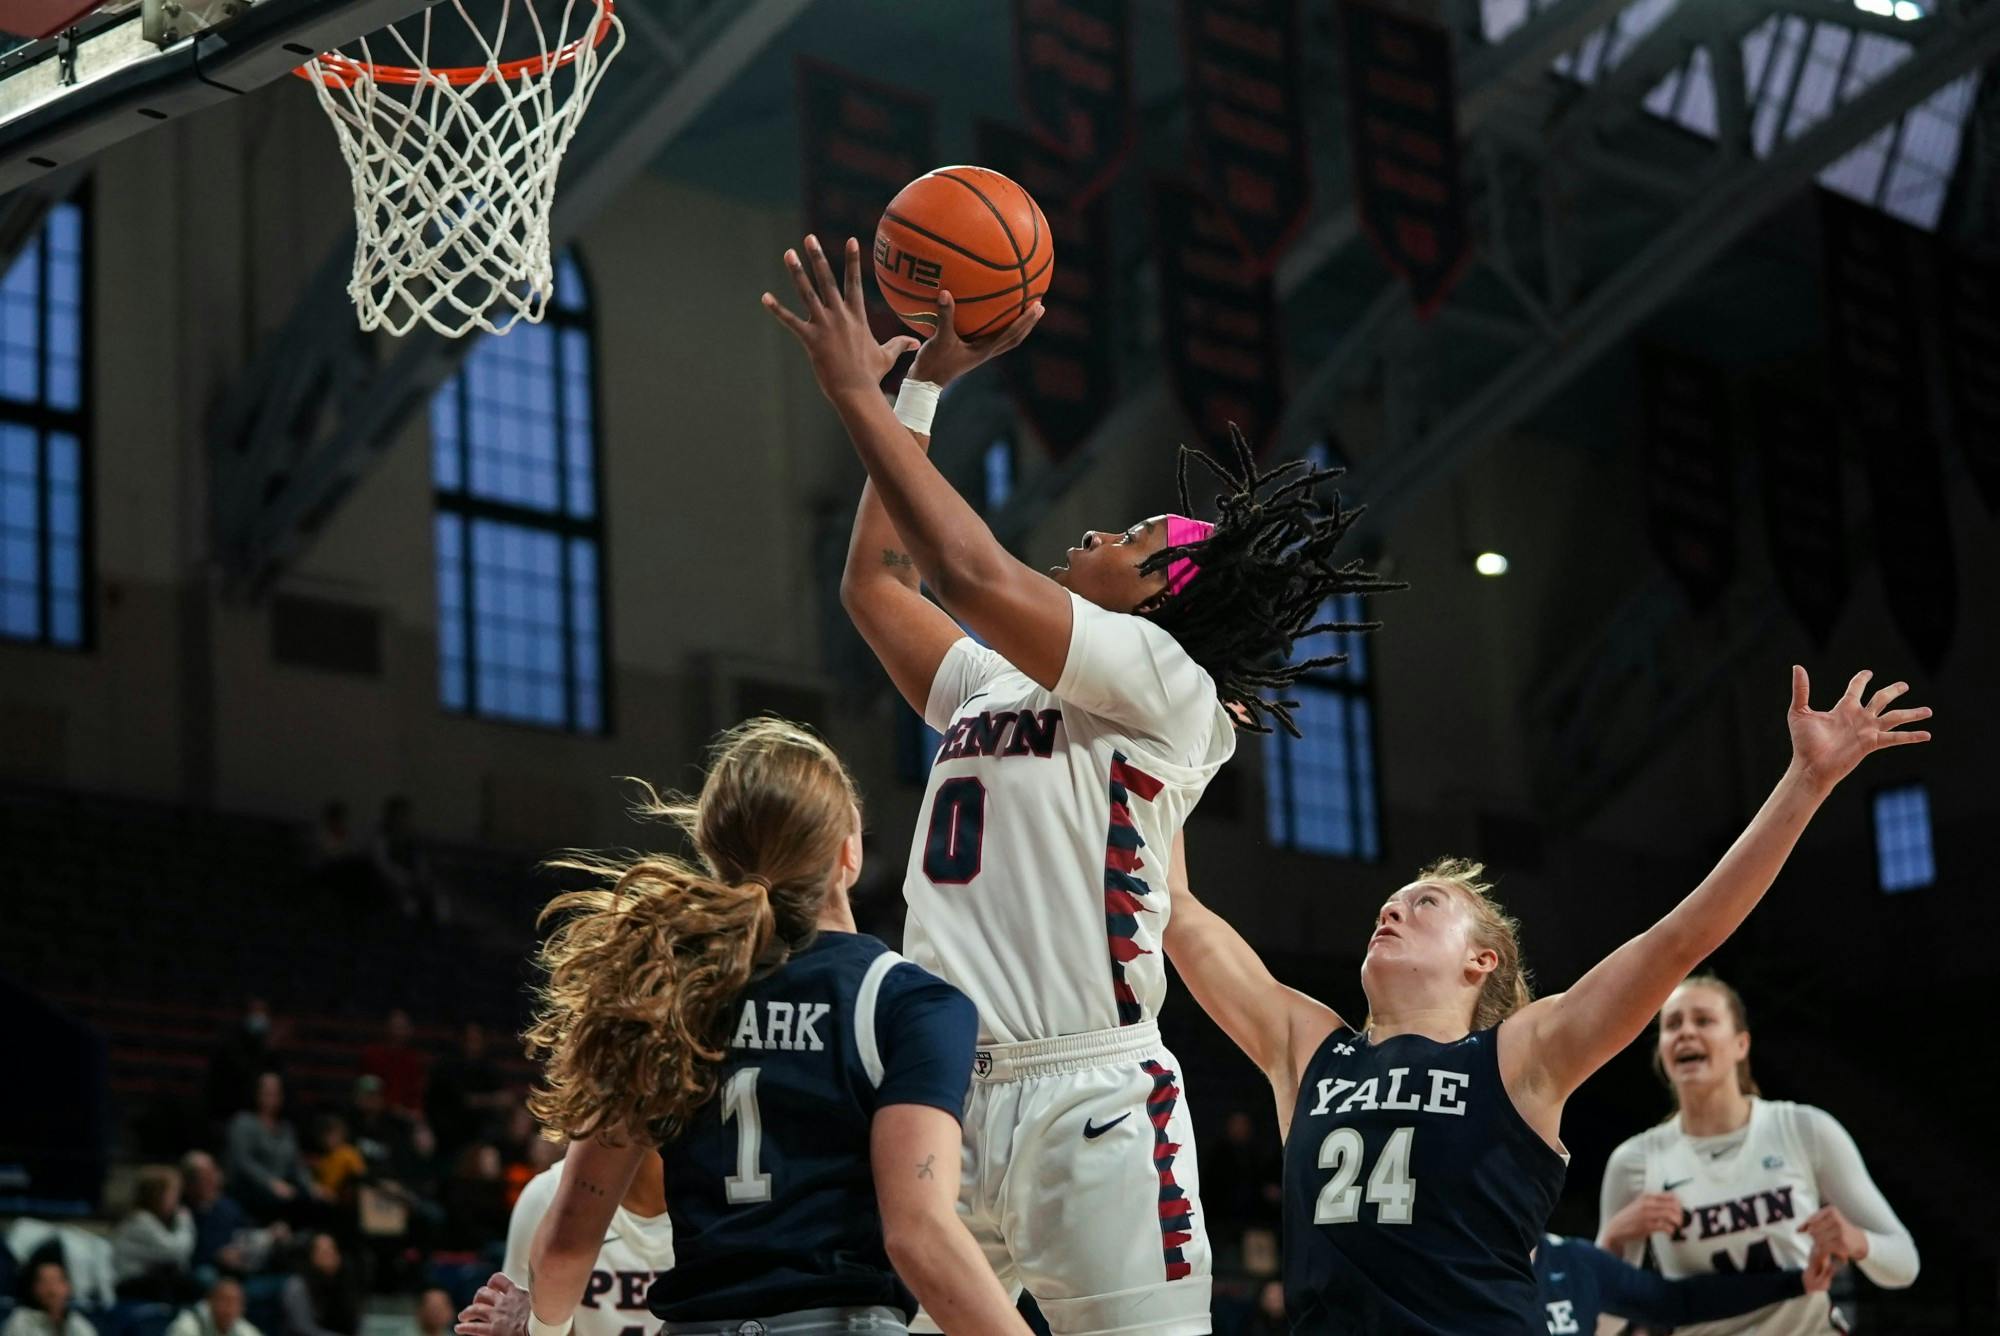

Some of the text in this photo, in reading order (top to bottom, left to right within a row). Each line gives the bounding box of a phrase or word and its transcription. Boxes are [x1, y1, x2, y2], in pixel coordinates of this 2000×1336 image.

[923, 776, 986, 885] 0
[728, 999, 831, 1051] ARK
[1310, 1067, 1470, 1116] YALE
[720, 1066, 773, 1205] 1
[1313, 1126, 1416, 1225] 24
[581, 1270, 668, 1309] PE
